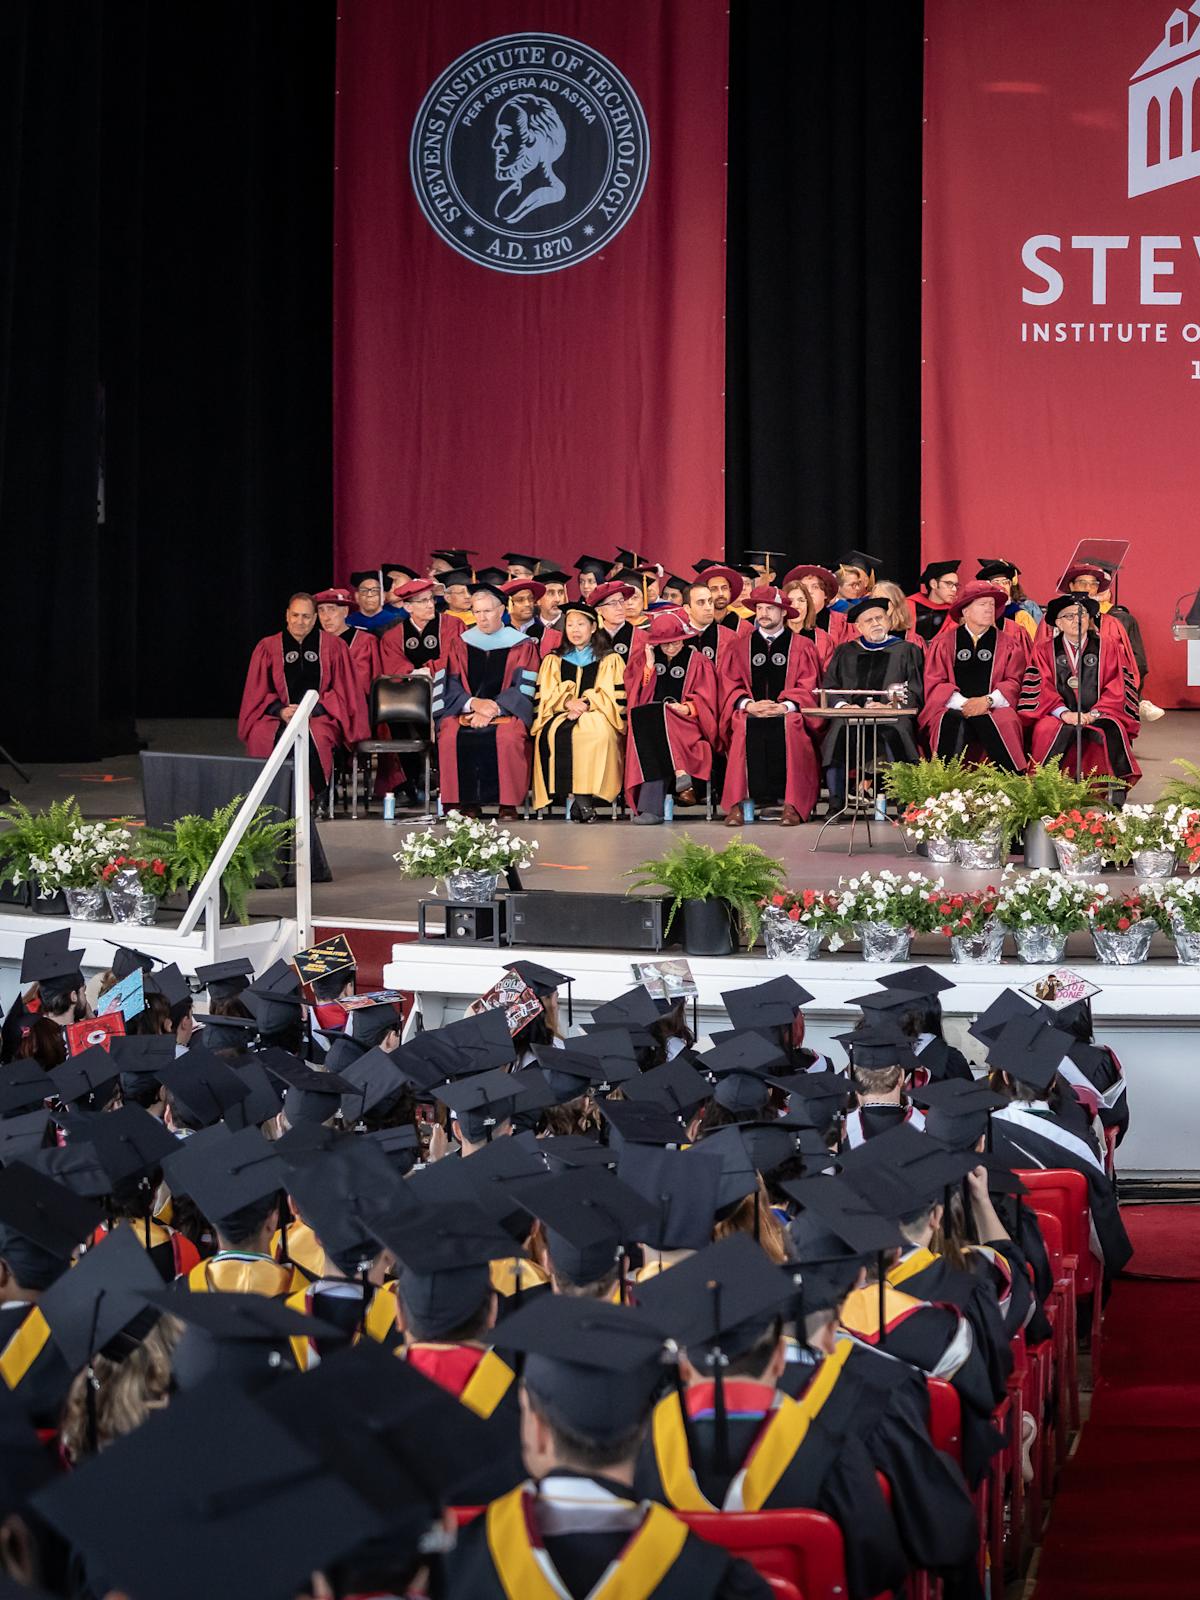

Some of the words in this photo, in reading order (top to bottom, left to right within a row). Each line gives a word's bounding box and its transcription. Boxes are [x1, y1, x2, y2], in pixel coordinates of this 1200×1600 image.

[551, 50, 583, 72] OF
[437, 47, 545, 117] INSTITUTE
[462, 100, 485, 127] PER
[485, 77, 537, 104] ASPERA
[540, 78, 560, 92] AD
[560, 87, 597, 125] ASTRA
[582, 66, 635, 220] TECHNOLOGY
[424, 118, 461, 222] STEVENS
[486, 238, 527, 260] A.D.
[533, 235, 573, 260] 1870
[1021, 323, 1167, 343] INSTITUTE
[1056, 991, 1083, 999] DONE
